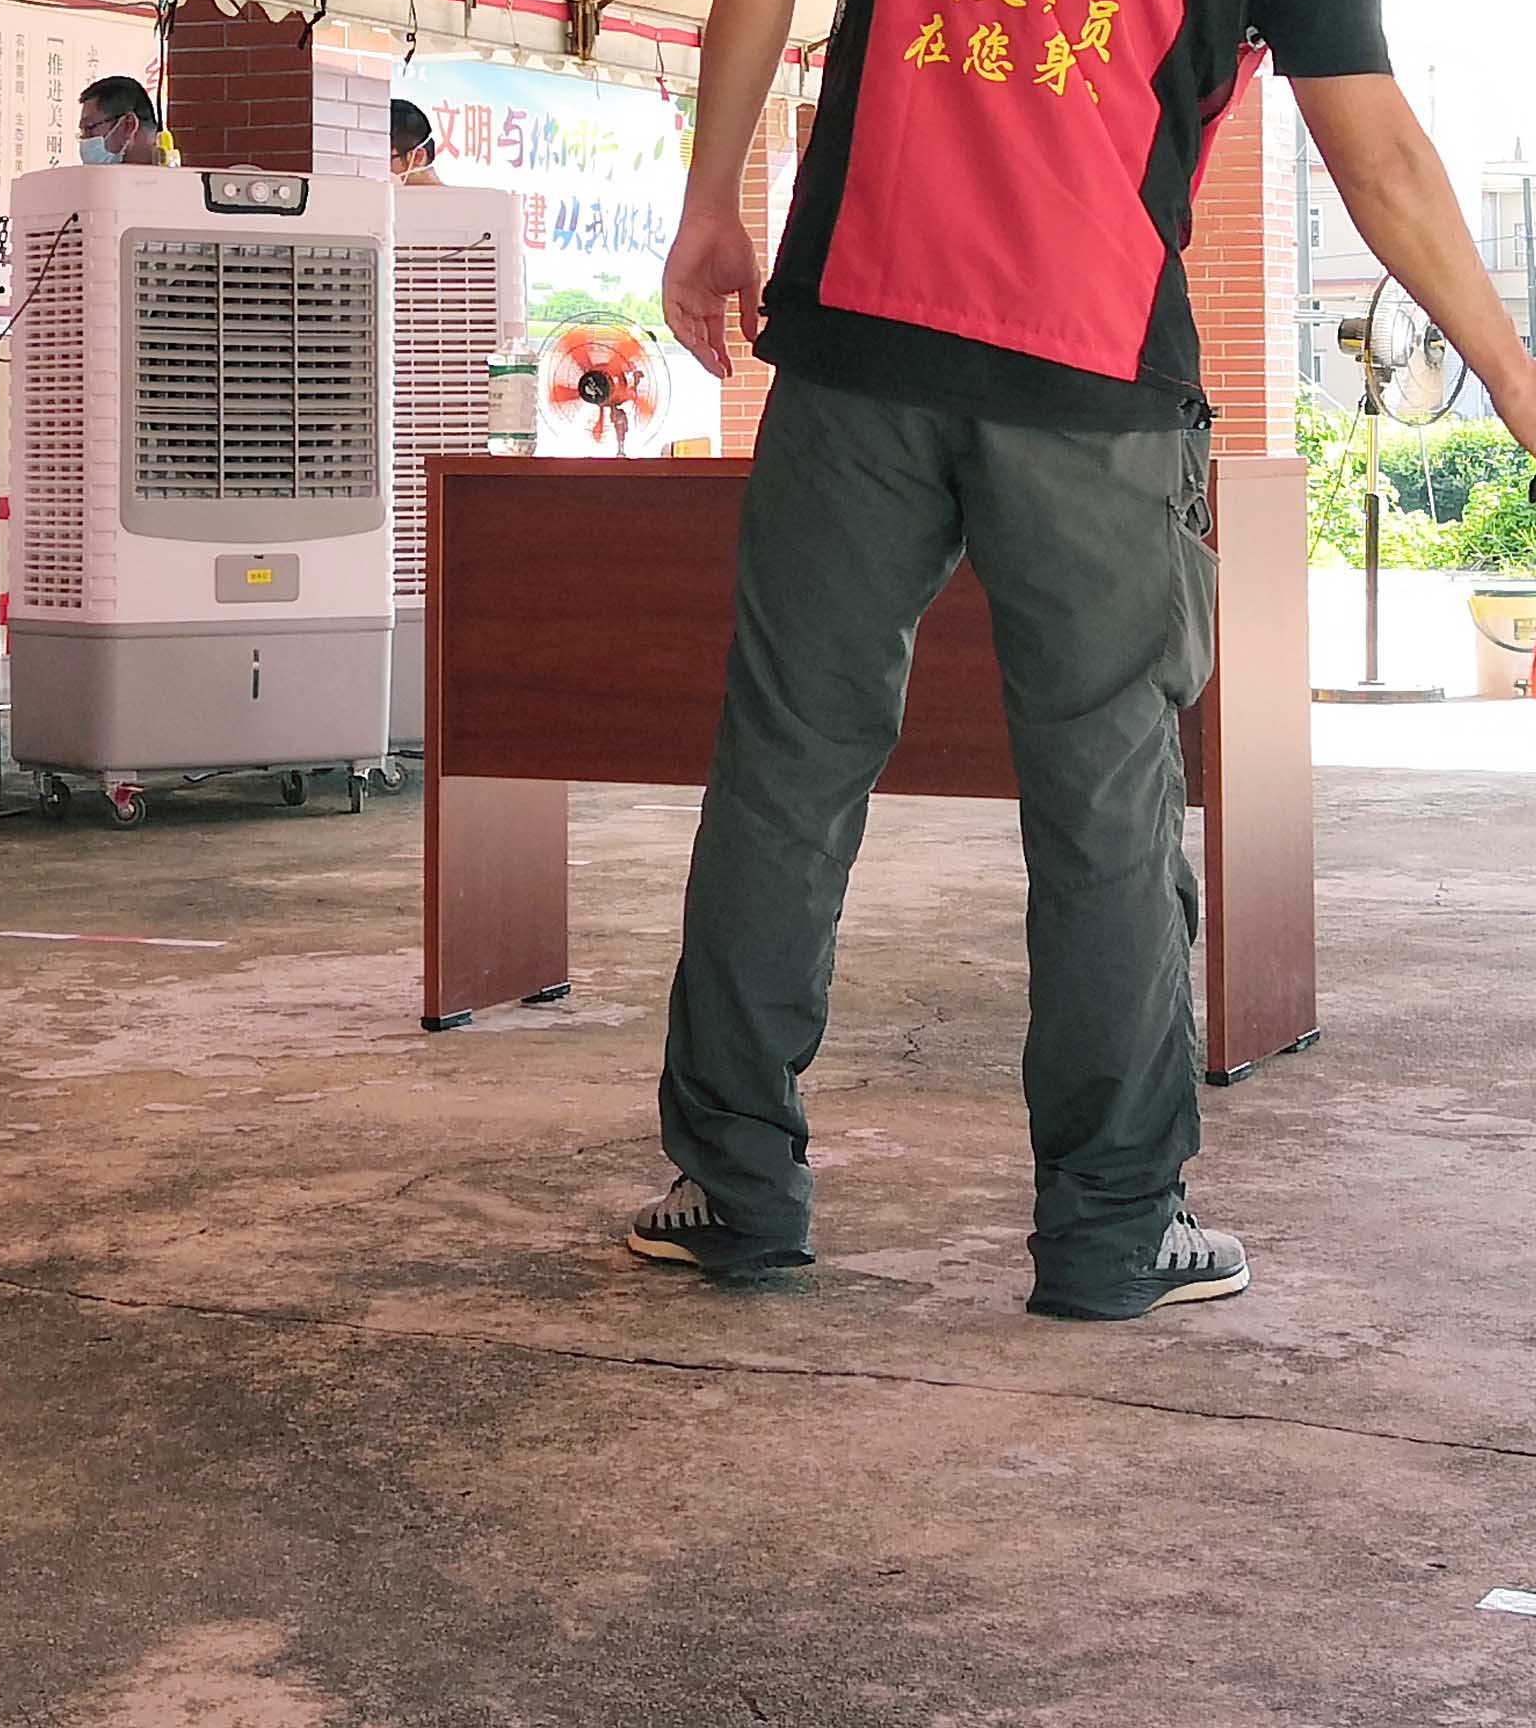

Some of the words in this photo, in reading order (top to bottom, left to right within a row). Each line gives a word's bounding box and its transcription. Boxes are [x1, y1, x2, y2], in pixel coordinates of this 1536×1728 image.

[903, 13, 1100, 105] 在您身
[505, 190, 665, 262] 建从我做起
